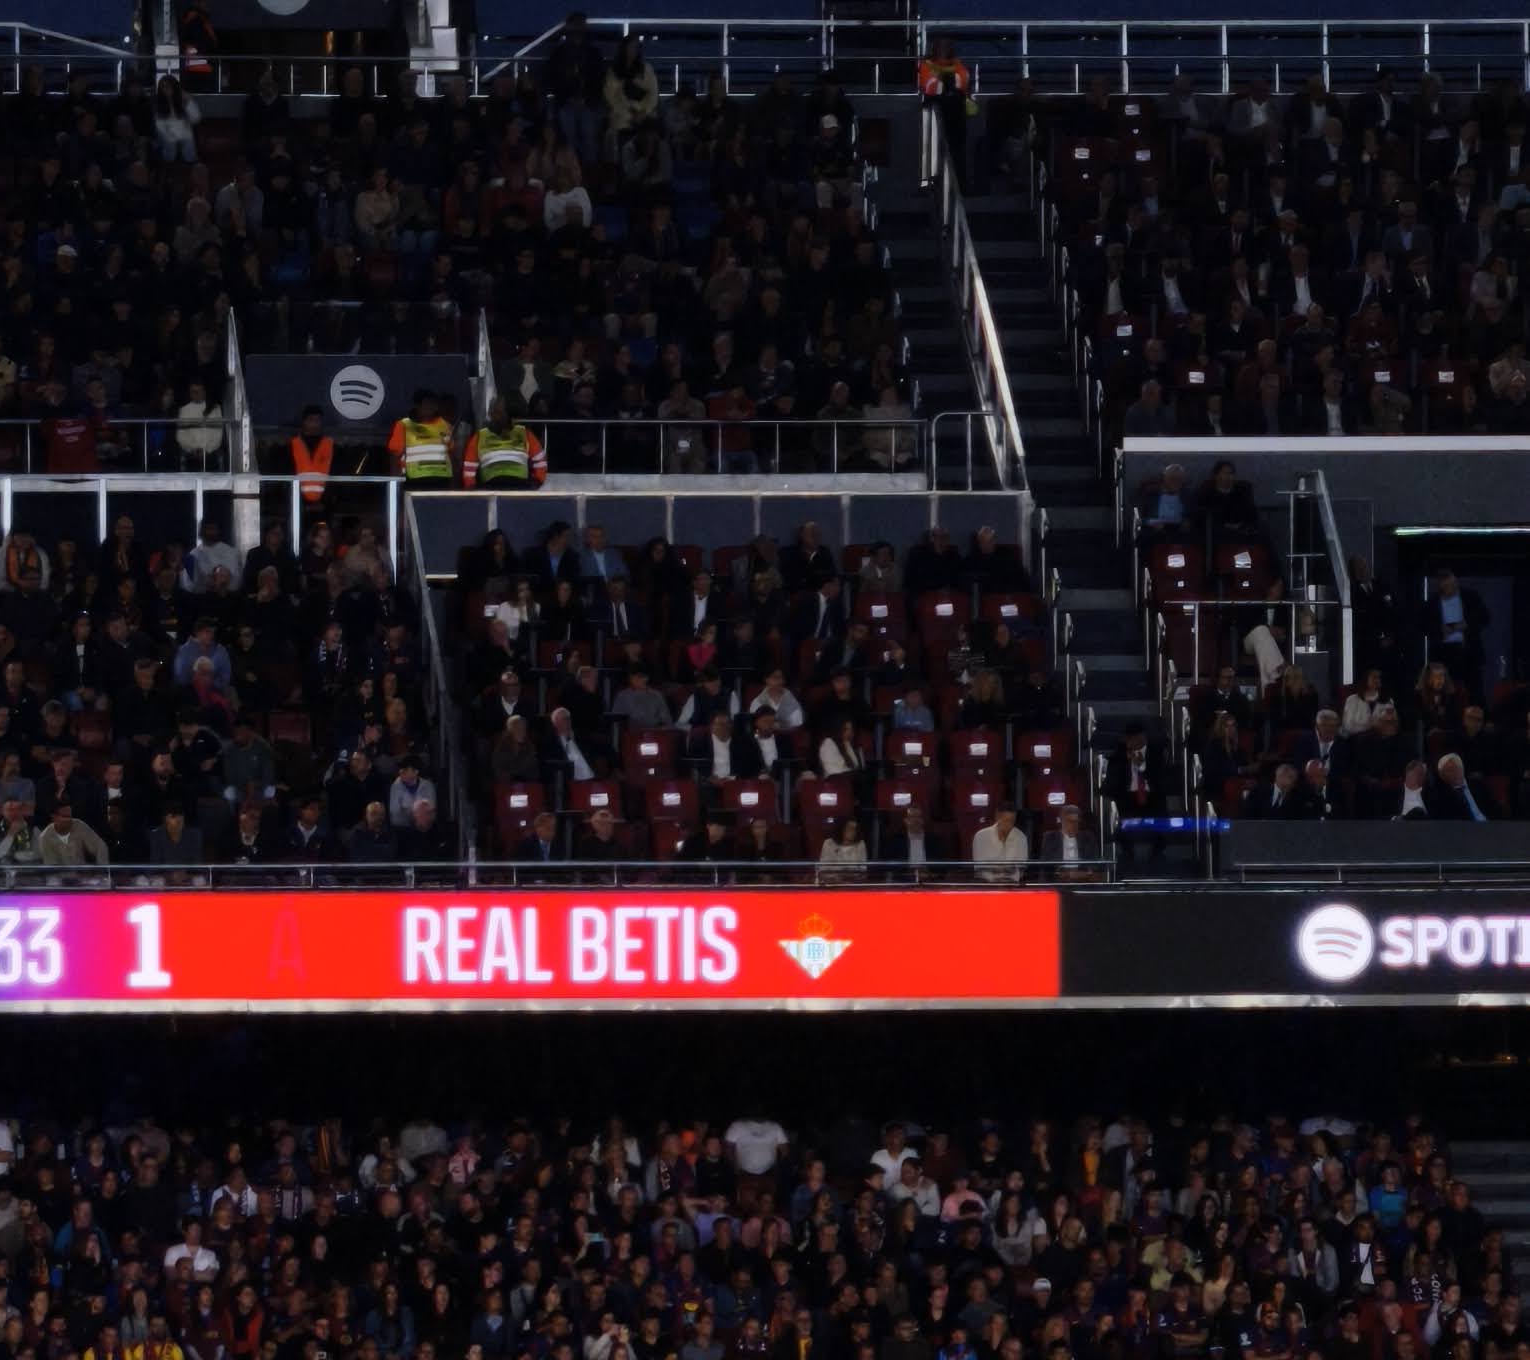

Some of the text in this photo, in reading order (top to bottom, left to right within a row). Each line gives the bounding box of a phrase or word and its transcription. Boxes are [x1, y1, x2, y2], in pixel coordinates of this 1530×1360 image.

[127, 903, 172, 989] 1
[402, 906, 739, 983] REAL BETIS
